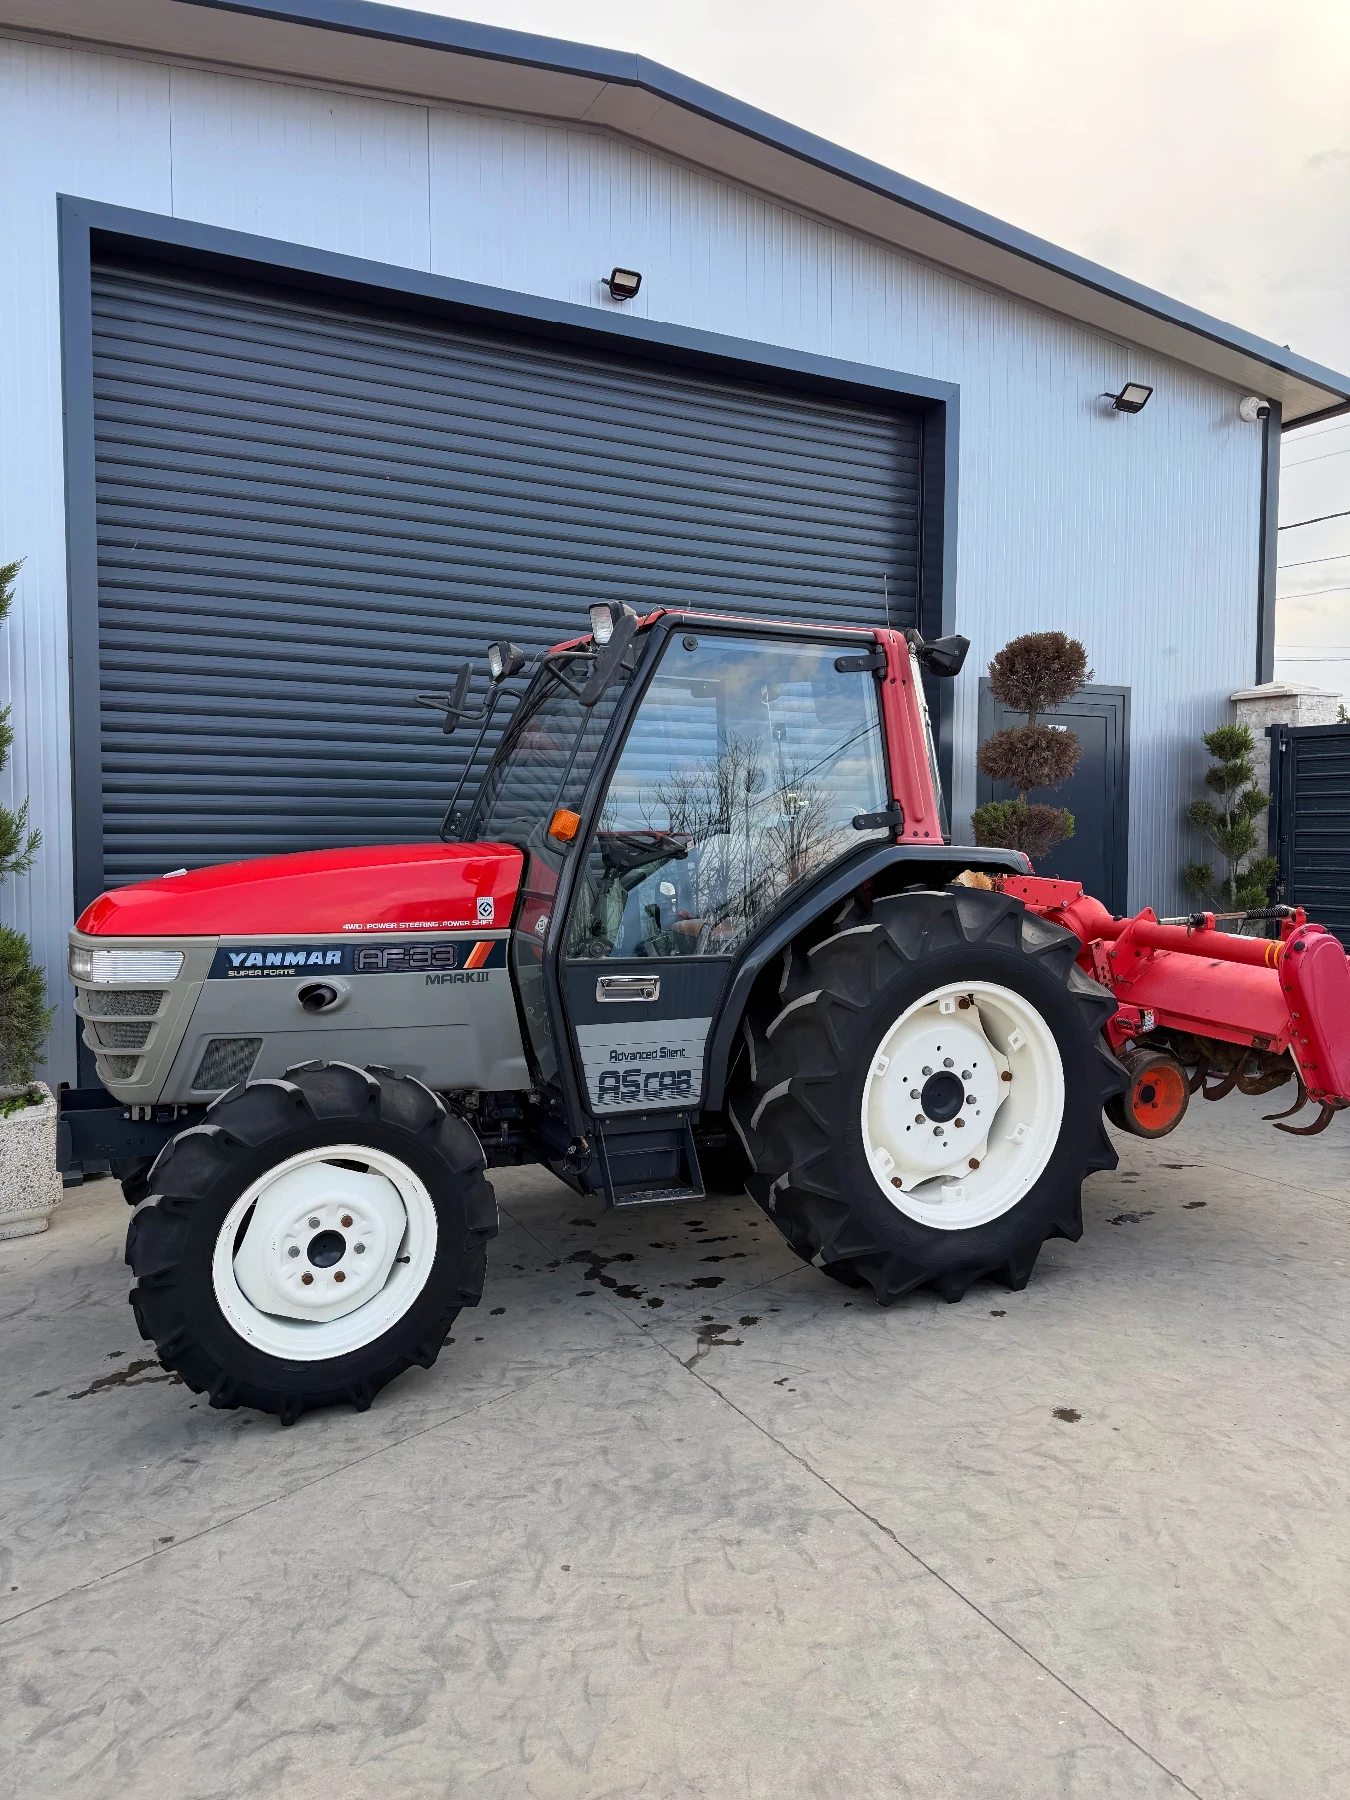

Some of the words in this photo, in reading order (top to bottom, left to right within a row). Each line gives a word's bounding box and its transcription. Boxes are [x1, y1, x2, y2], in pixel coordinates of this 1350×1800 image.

[228, 950, 342, 967] YANMAR
[227, 969, 263, 977] SUPER
[263, 968, 296, 976] FORTE
[609, 1049, 658, 1062] Advanced
[659, 1046, 686, 1059] Silent
